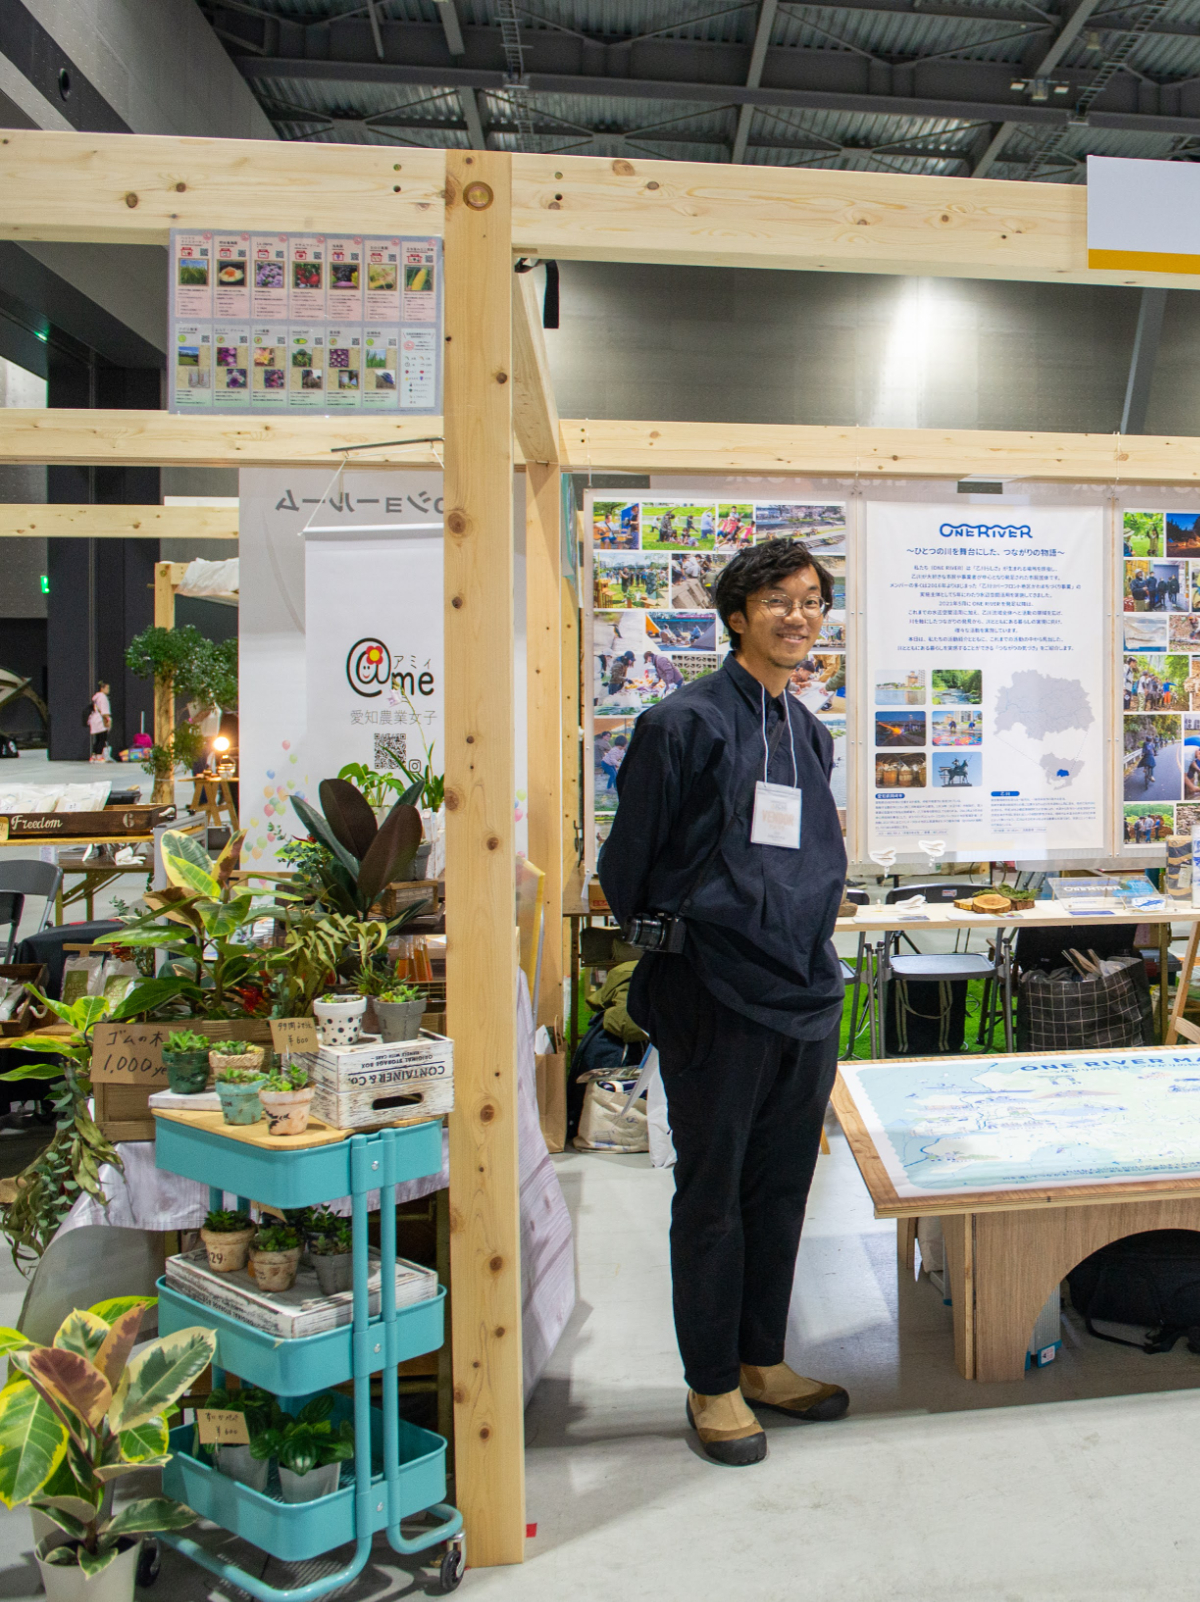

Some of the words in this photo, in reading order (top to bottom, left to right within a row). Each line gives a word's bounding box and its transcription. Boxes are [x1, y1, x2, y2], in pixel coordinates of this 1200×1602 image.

[350, 709, 438, 726] 愛知農業女子
[10, 814, 63, 831] Freedom
[122, 813, 135, 828] 6
[106, 1030, 164, 1047] ゴムの木
[376, 1058, 403, 1067] STORAGE
[404, 1054, 433, 1063] ORIGINAL
[1020, 1062, 1077, 1072] ONE
[1085, 1058, 1163, 1068] RIVER
[348, 1076, 367, 1086] Co.
[369, 1074, 377, 1084] &
[379, 1065, 445, 1083] CONTAINER
